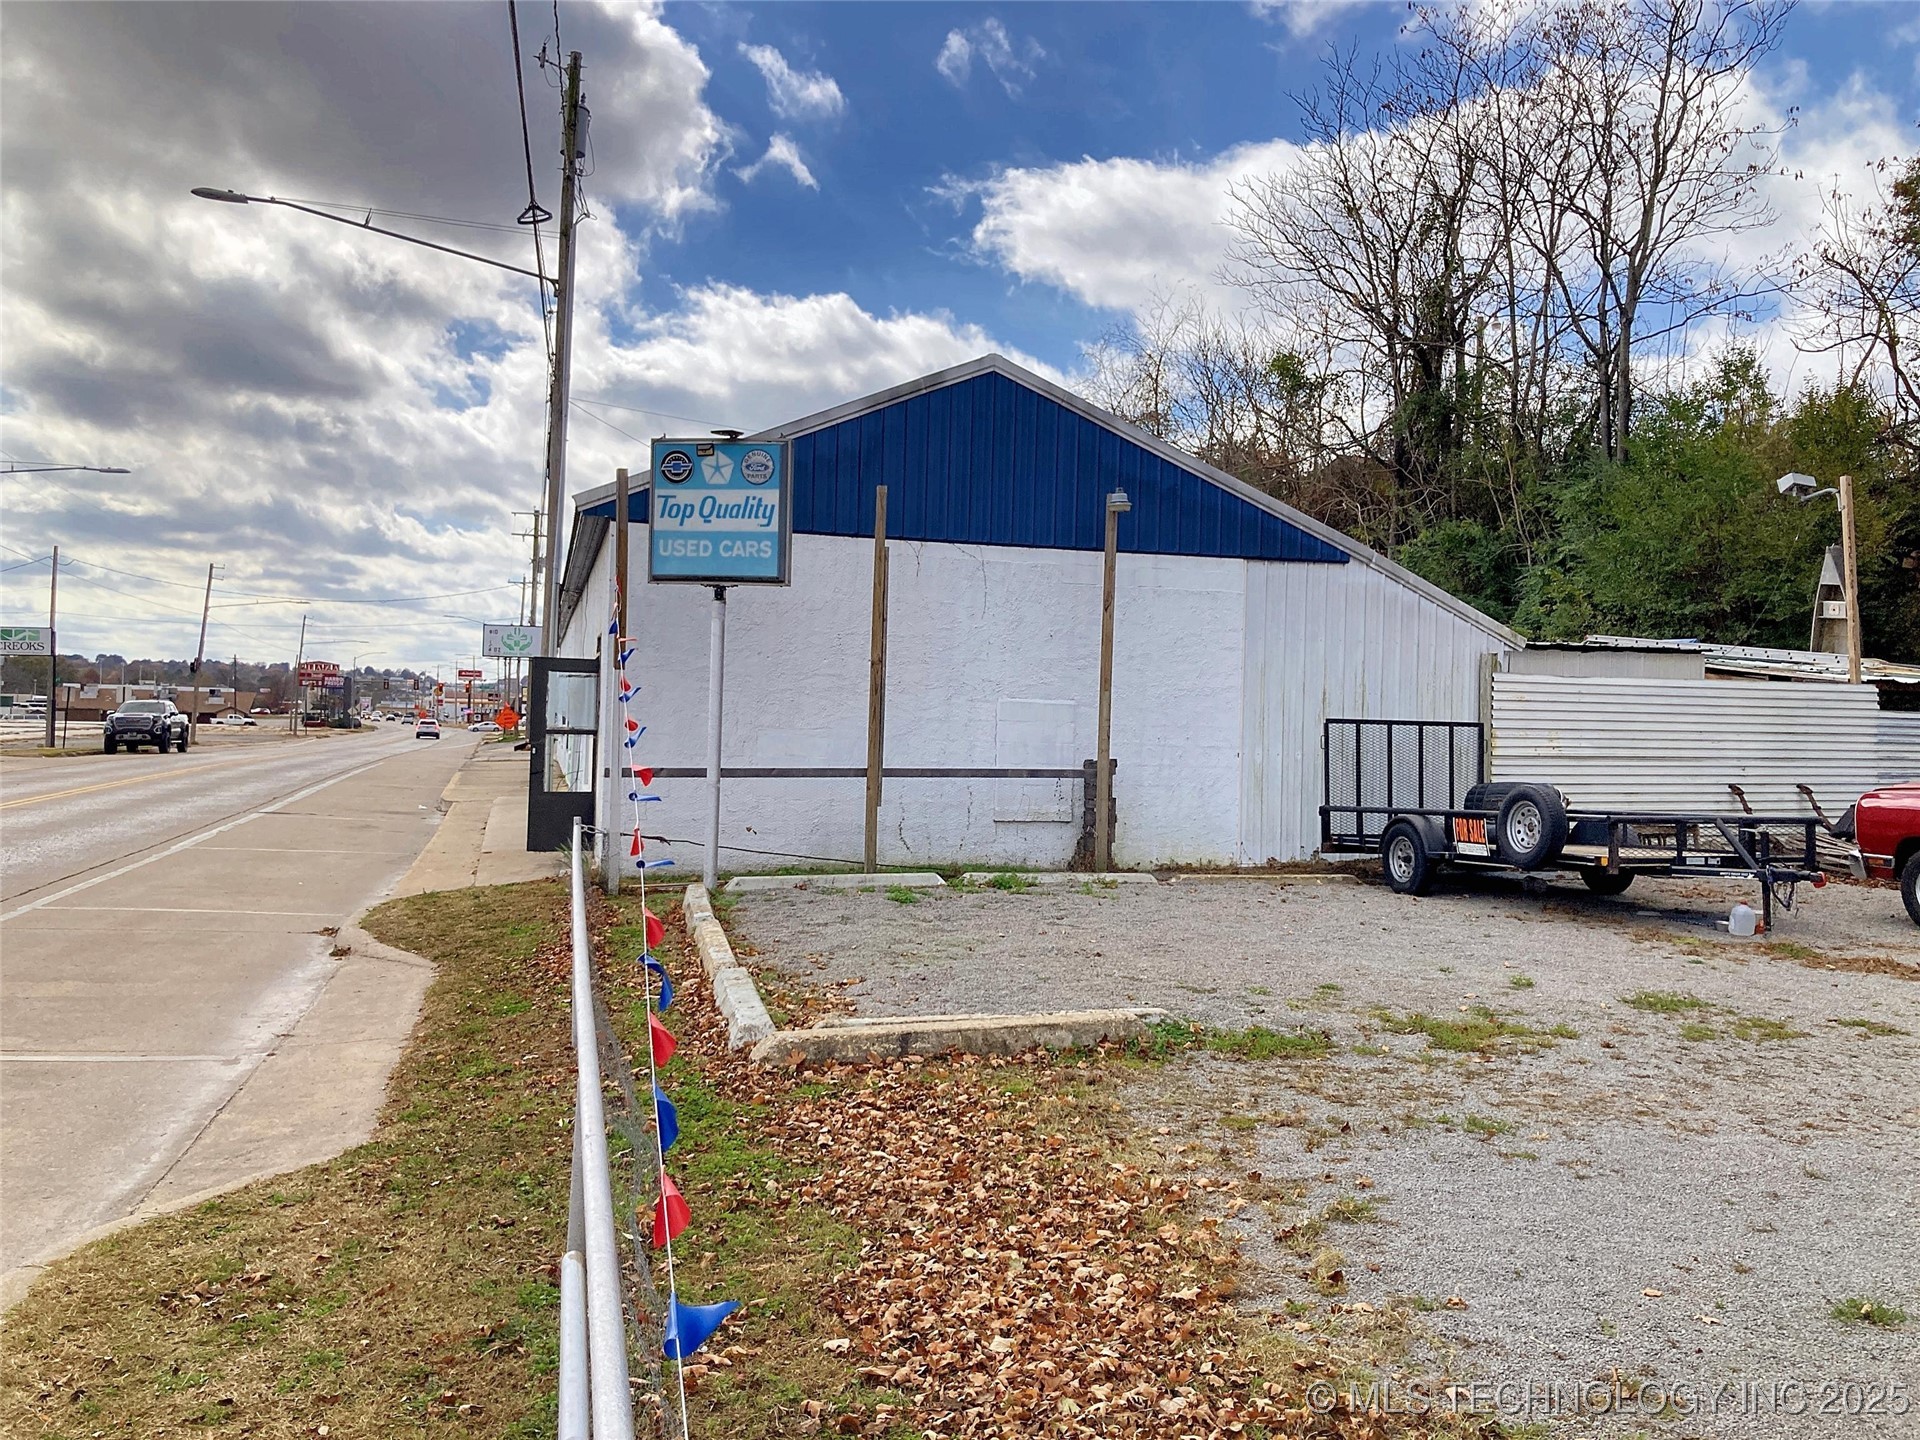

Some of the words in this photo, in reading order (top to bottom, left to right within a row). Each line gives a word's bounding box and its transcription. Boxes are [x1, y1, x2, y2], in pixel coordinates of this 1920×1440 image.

[744, 451, 771, 464] GENUINE
[749, 463, 766, 471] Ford
[657, 495, 695, 527] Top
[699, 495, 776, 528] Quality
[659, 539, 713, 557] USED
[719, 540, 772, 558] CARS
[1455, 817, 1469, 842] FOR
[1469, 818, 1486, 844] SALE
